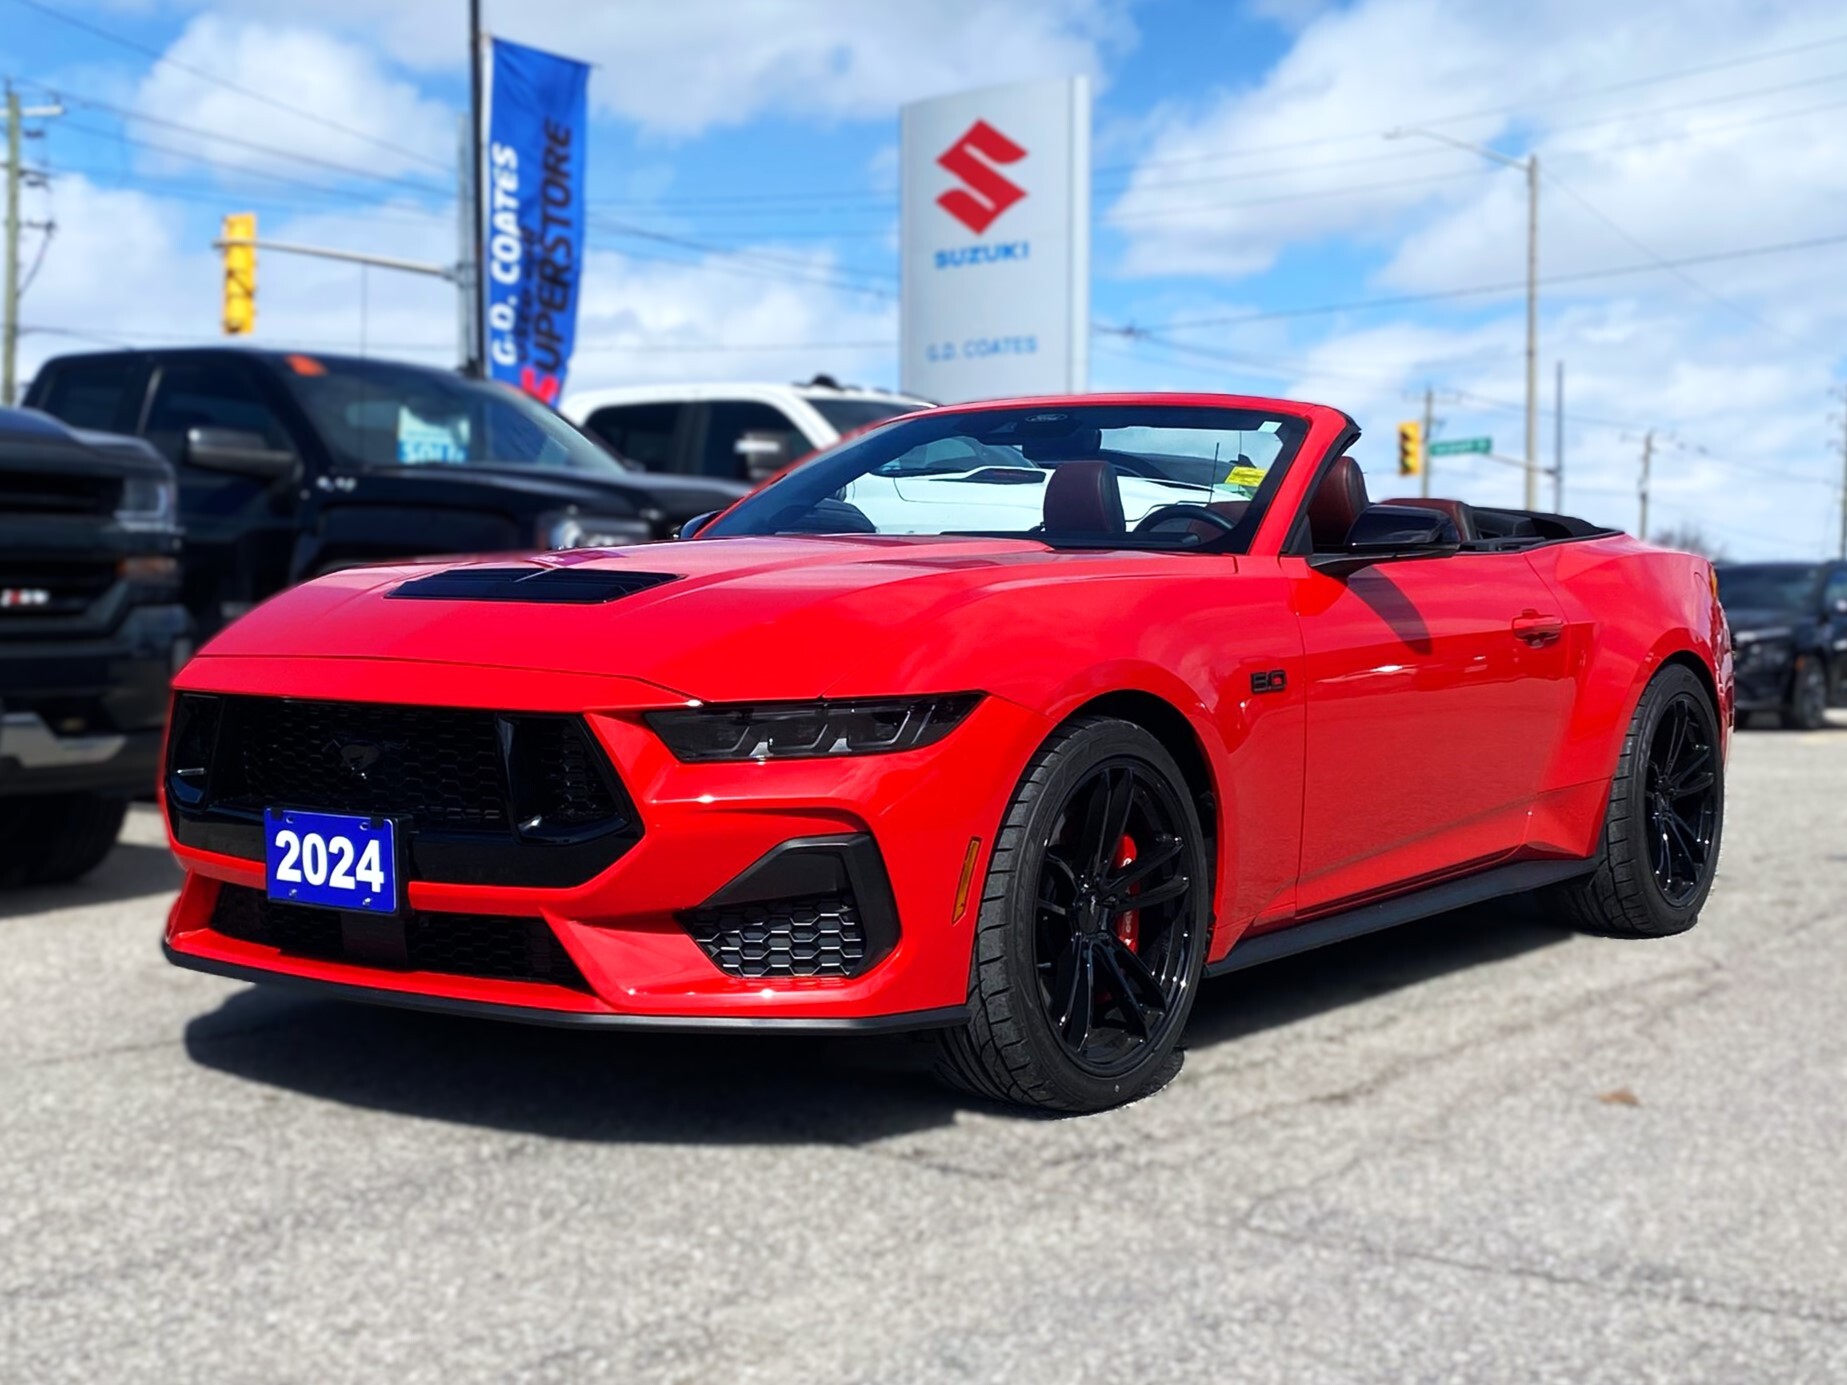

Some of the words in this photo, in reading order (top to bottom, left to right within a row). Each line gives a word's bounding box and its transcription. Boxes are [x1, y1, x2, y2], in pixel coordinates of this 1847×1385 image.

[491, 142, 521, 284] COATES
[521, 118, 573, 403] SUPERSTORE
[935, 242, 1029, 268] SUZUKI
[491, 297, 517, 366] G.D.
[963, 336, 1037, 357] COATES
[275, 829, 385, 893] 2024
